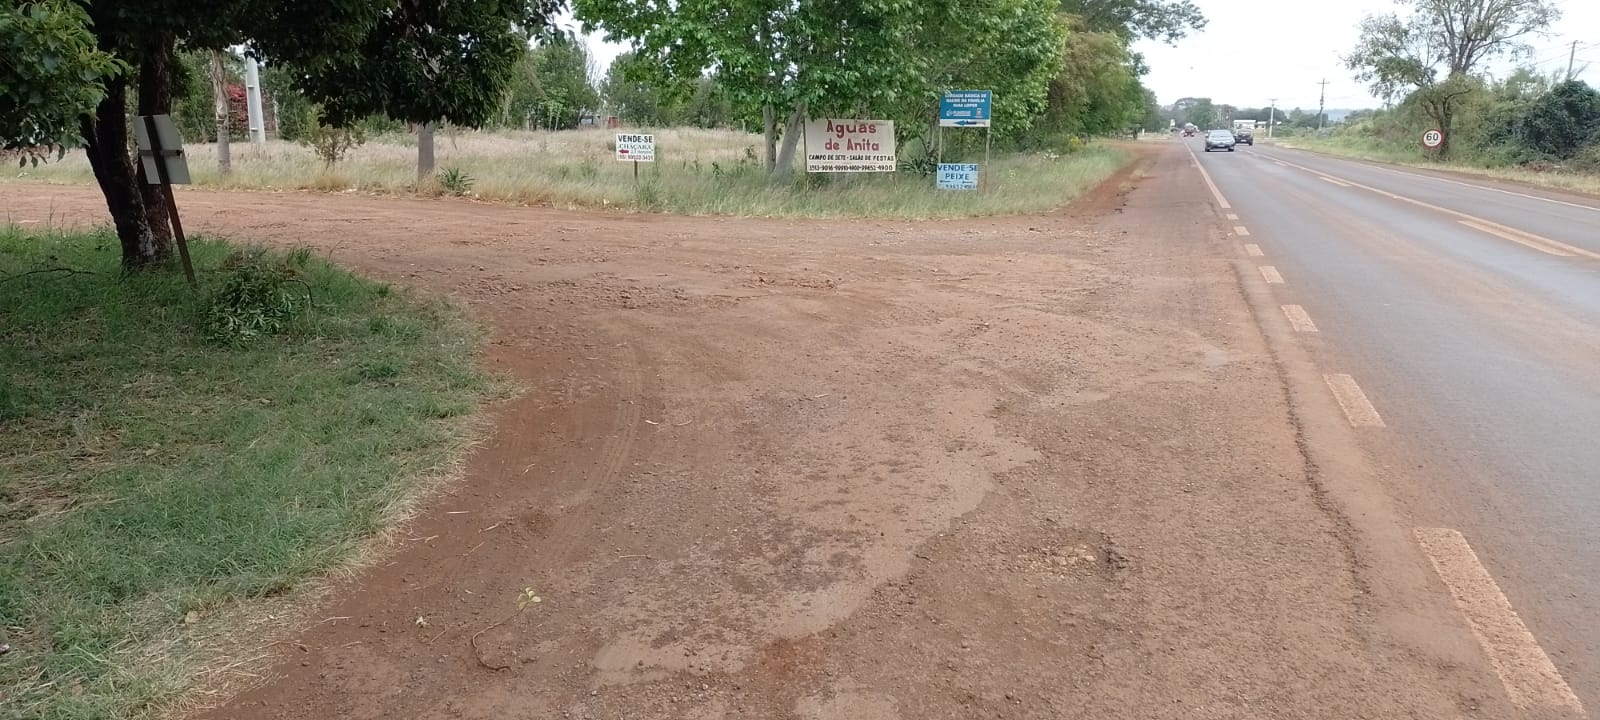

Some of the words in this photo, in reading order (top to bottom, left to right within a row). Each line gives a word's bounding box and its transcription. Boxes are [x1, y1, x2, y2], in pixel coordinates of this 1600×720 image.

[618, 135, 653, 143] VENDE-SE
[825, 138, 840, 151] de
[847, 138, 879, 151] Anita
